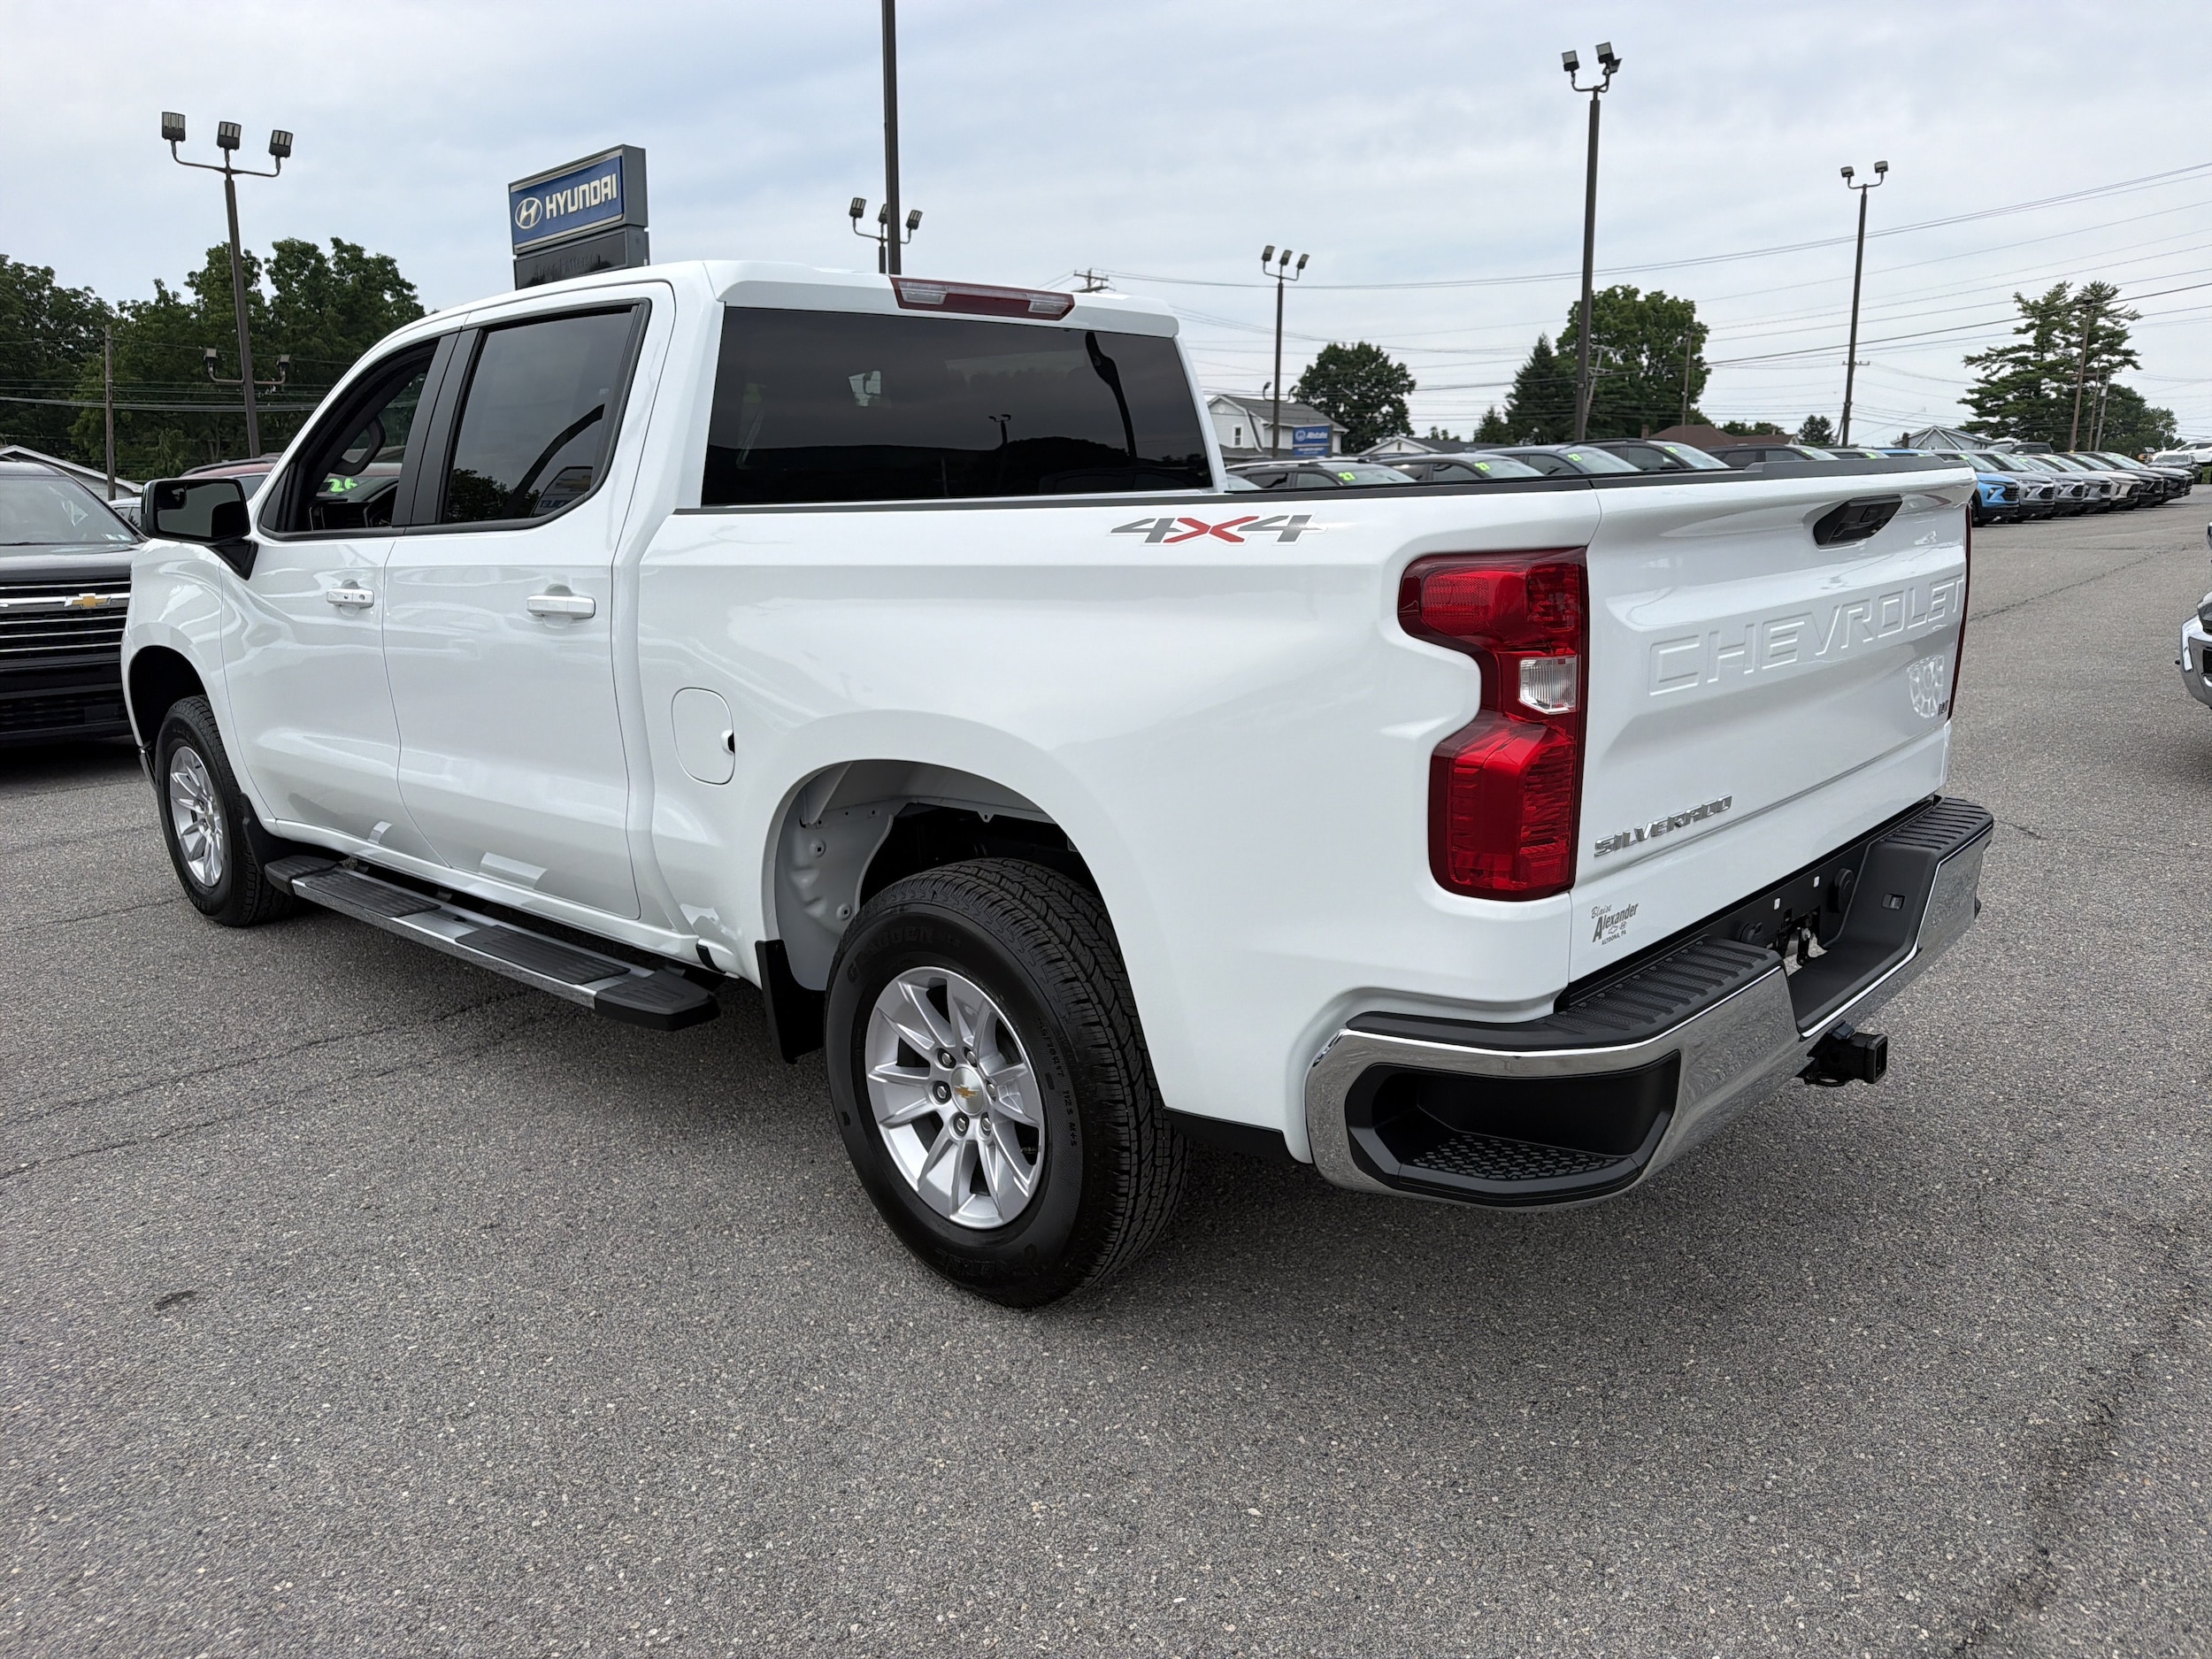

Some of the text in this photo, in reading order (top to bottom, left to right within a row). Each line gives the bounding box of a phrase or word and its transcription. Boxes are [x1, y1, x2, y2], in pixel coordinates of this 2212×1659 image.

[545, 173, 618, 220] HYUNDAI
[1647, 573, 1964, 696] CHEVROLET
[1594, 794, 1732, 857] SILVERADO
[1592, 904, 1611, 918] Blaise
[1593, 903, 1639, 942] Alexander
